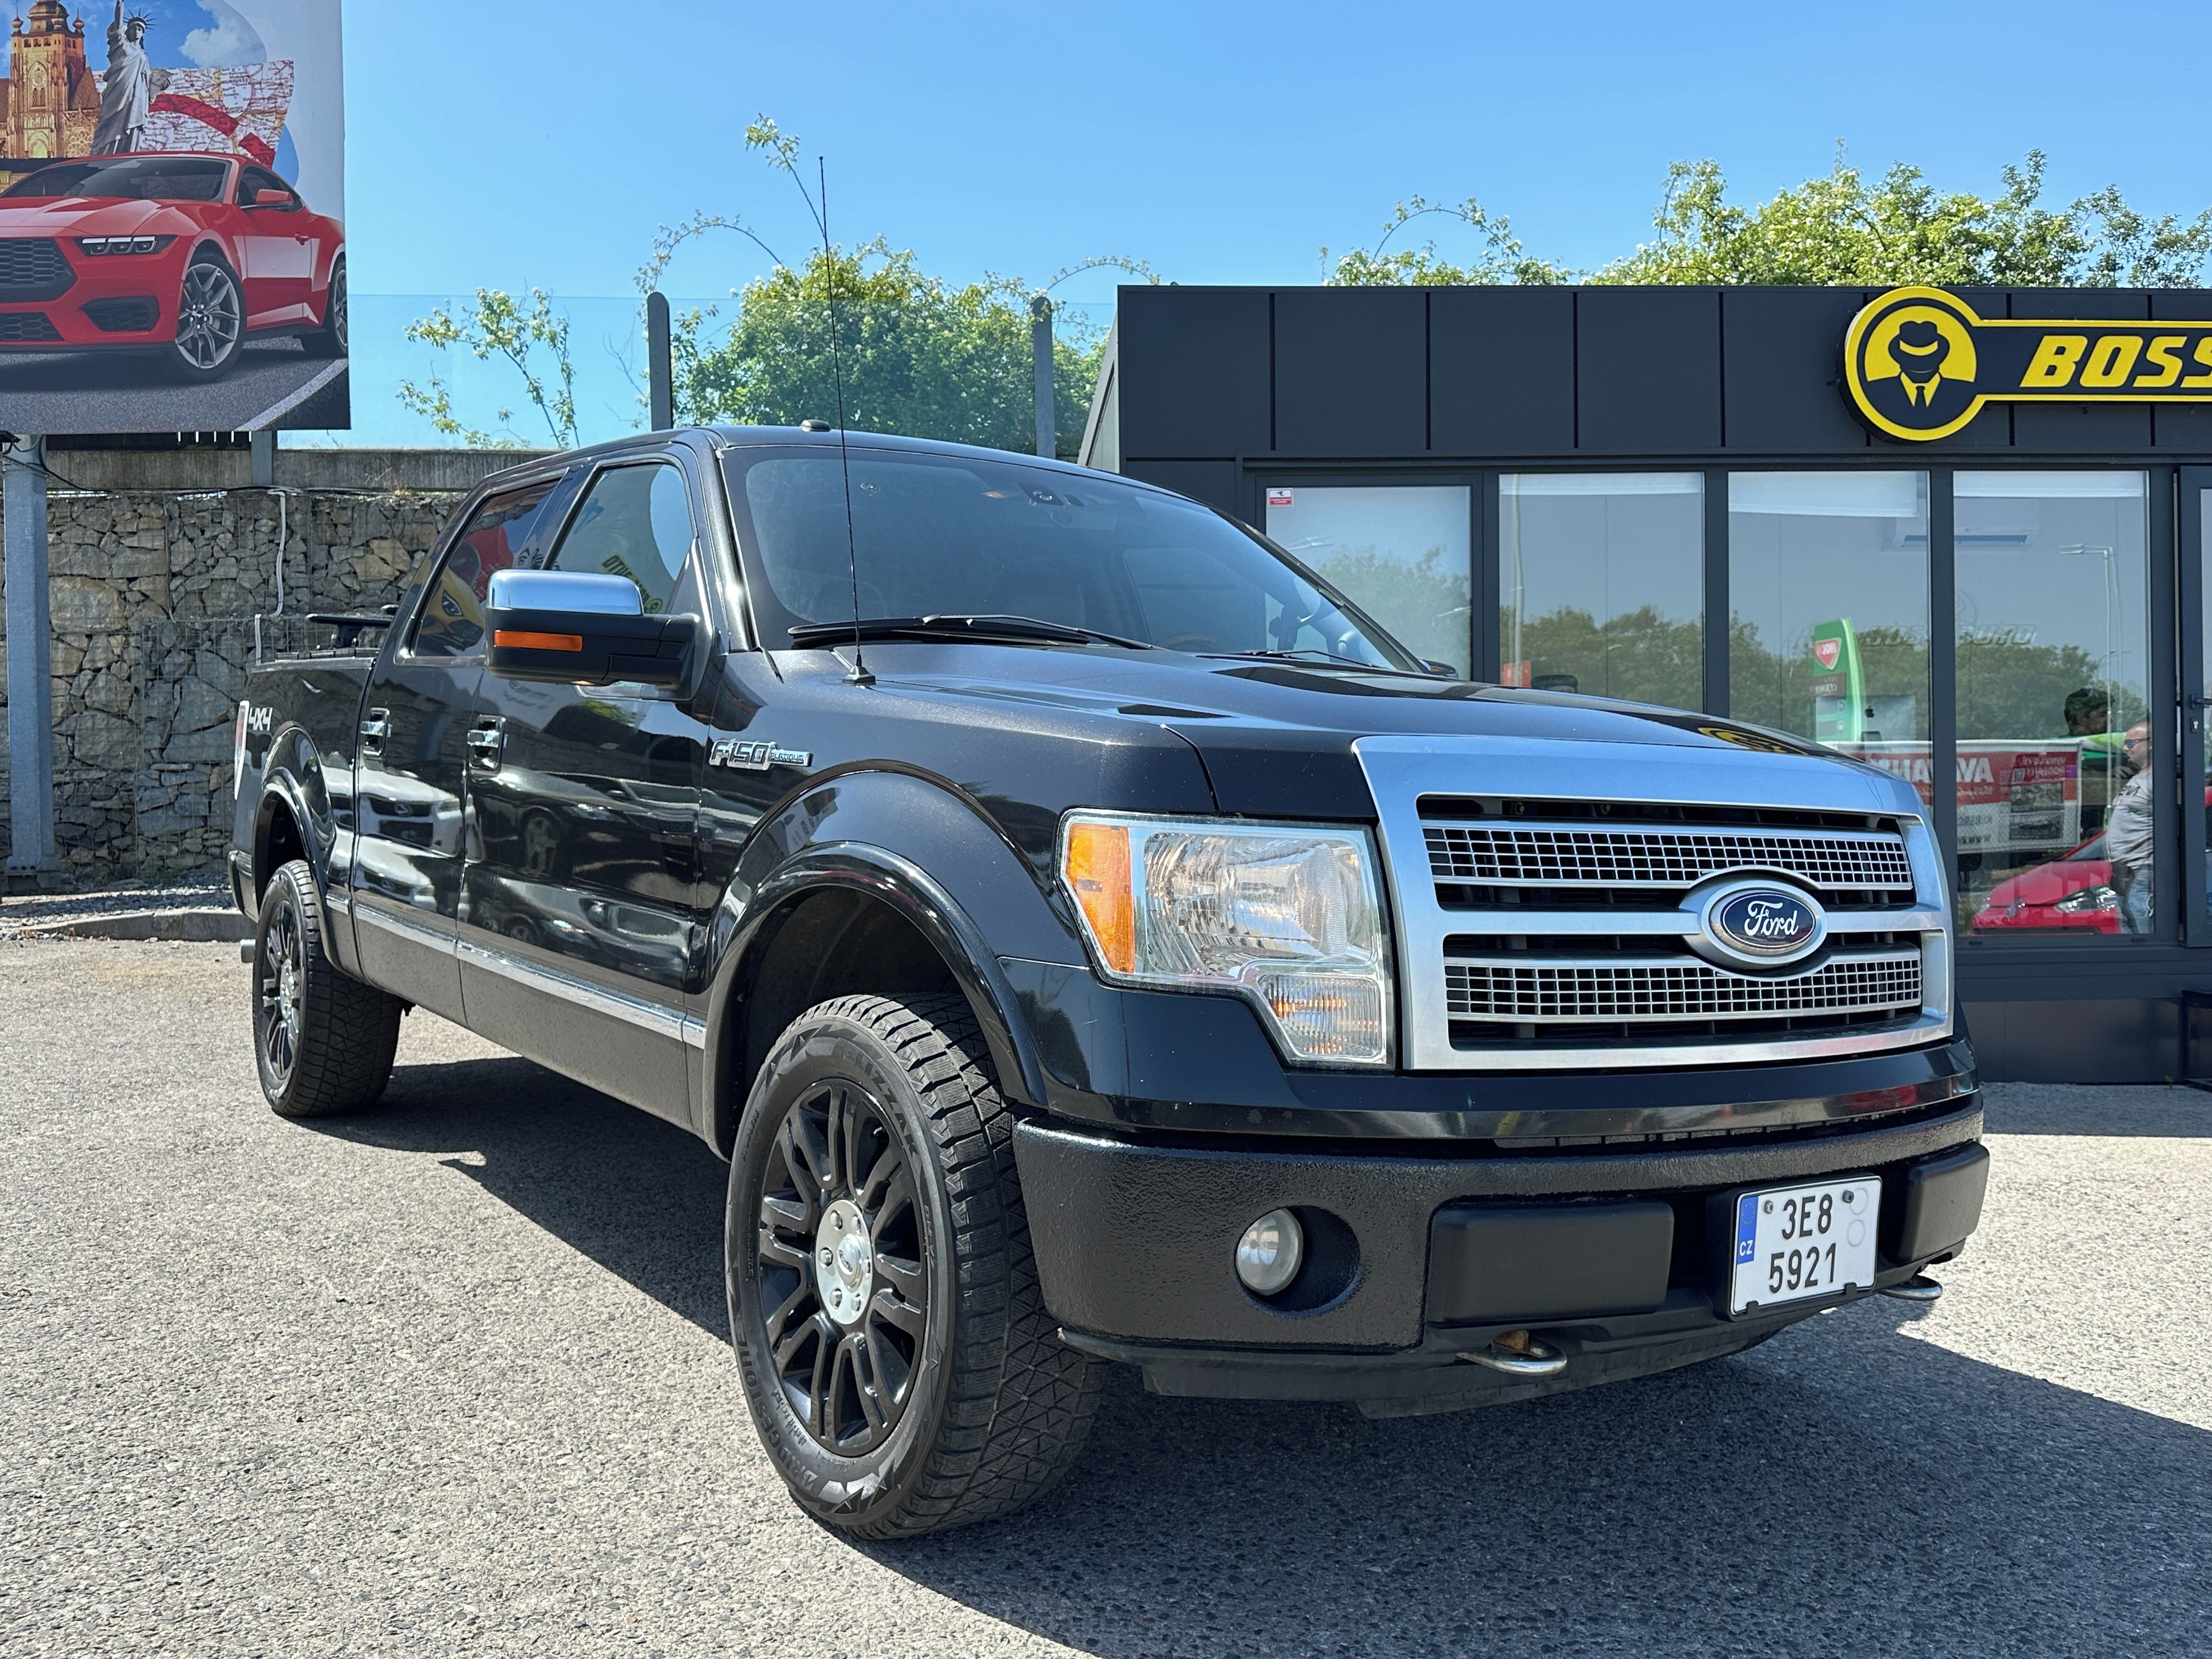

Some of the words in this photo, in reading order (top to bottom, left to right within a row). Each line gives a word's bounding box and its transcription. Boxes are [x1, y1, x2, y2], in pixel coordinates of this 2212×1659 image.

[2019, 335, 2212, 388] BOSS
[1744, 900, 1799, 936] Ford
[1781, 1193, 1833, 1240] 3E8
[1739, 1239, 1753, 1256] CZ
[1768, 1243, 1836, 1294] 5921
[735, 1330, 818, 1492] BRIDGESTONE
